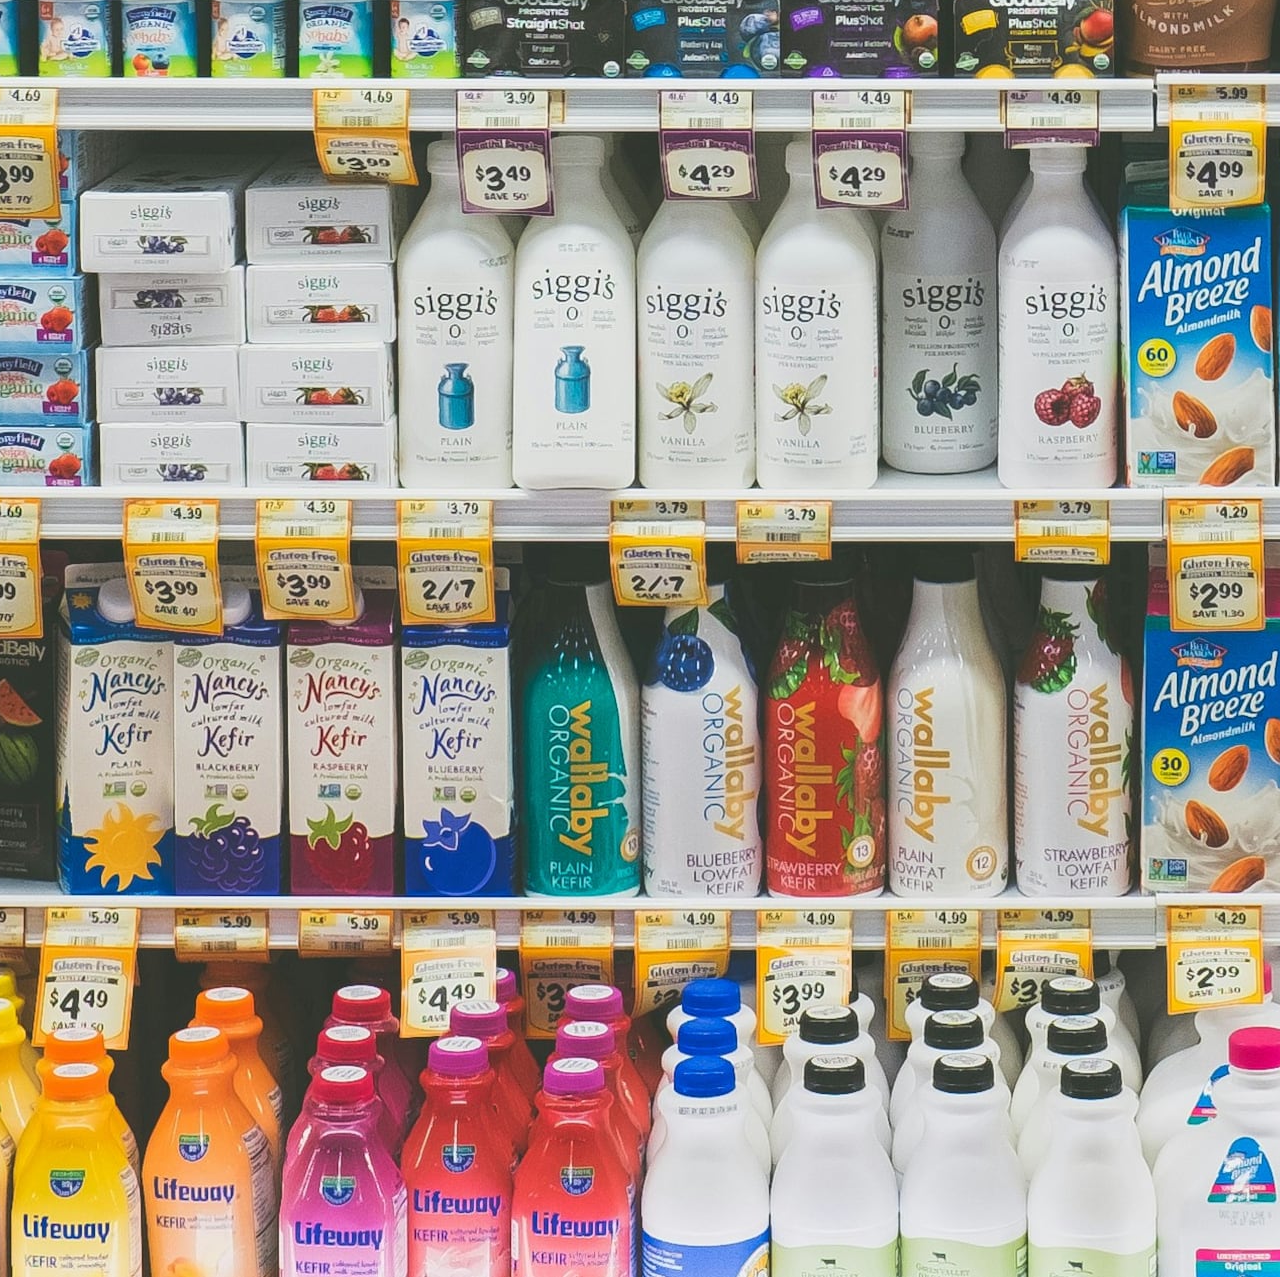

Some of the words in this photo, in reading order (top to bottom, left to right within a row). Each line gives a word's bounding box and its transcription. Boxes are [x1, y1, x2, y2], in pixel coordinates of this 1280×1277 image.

[1137, 238, 1261, 301] Almond
[414, 290, 498, 320] siggi's
[645, 285, 728, 320] siggi's
[1164, 275, 1250, 327] Breeze
[1175, 308, 1241, 335] Almondmilk
[1146, 348, 1168, 362] 60
[914, 424, 975, 435] BLUEBERRY
[203, 657, 260, 676] Organic
[418, 672, 497, 712] Nancy's
[240, 714, 263, 727] milk
[425, 731, 483, 760] Kefir
[549, 704, 570, 832] ORGANIC
[559, 699, 609, 857] wallaby
[898, 846, 933, 864] PLAIN
[974, 856, 989, 868] 12
[550, 861, 594, 875] PLAIN
[892, 859, 946, 879] LOWFAT
[551, 876, 594, 889] KEFIR
[899, 876, 934, 892] KEFIR
[154, 1176, 237, 1203] Lifeway
